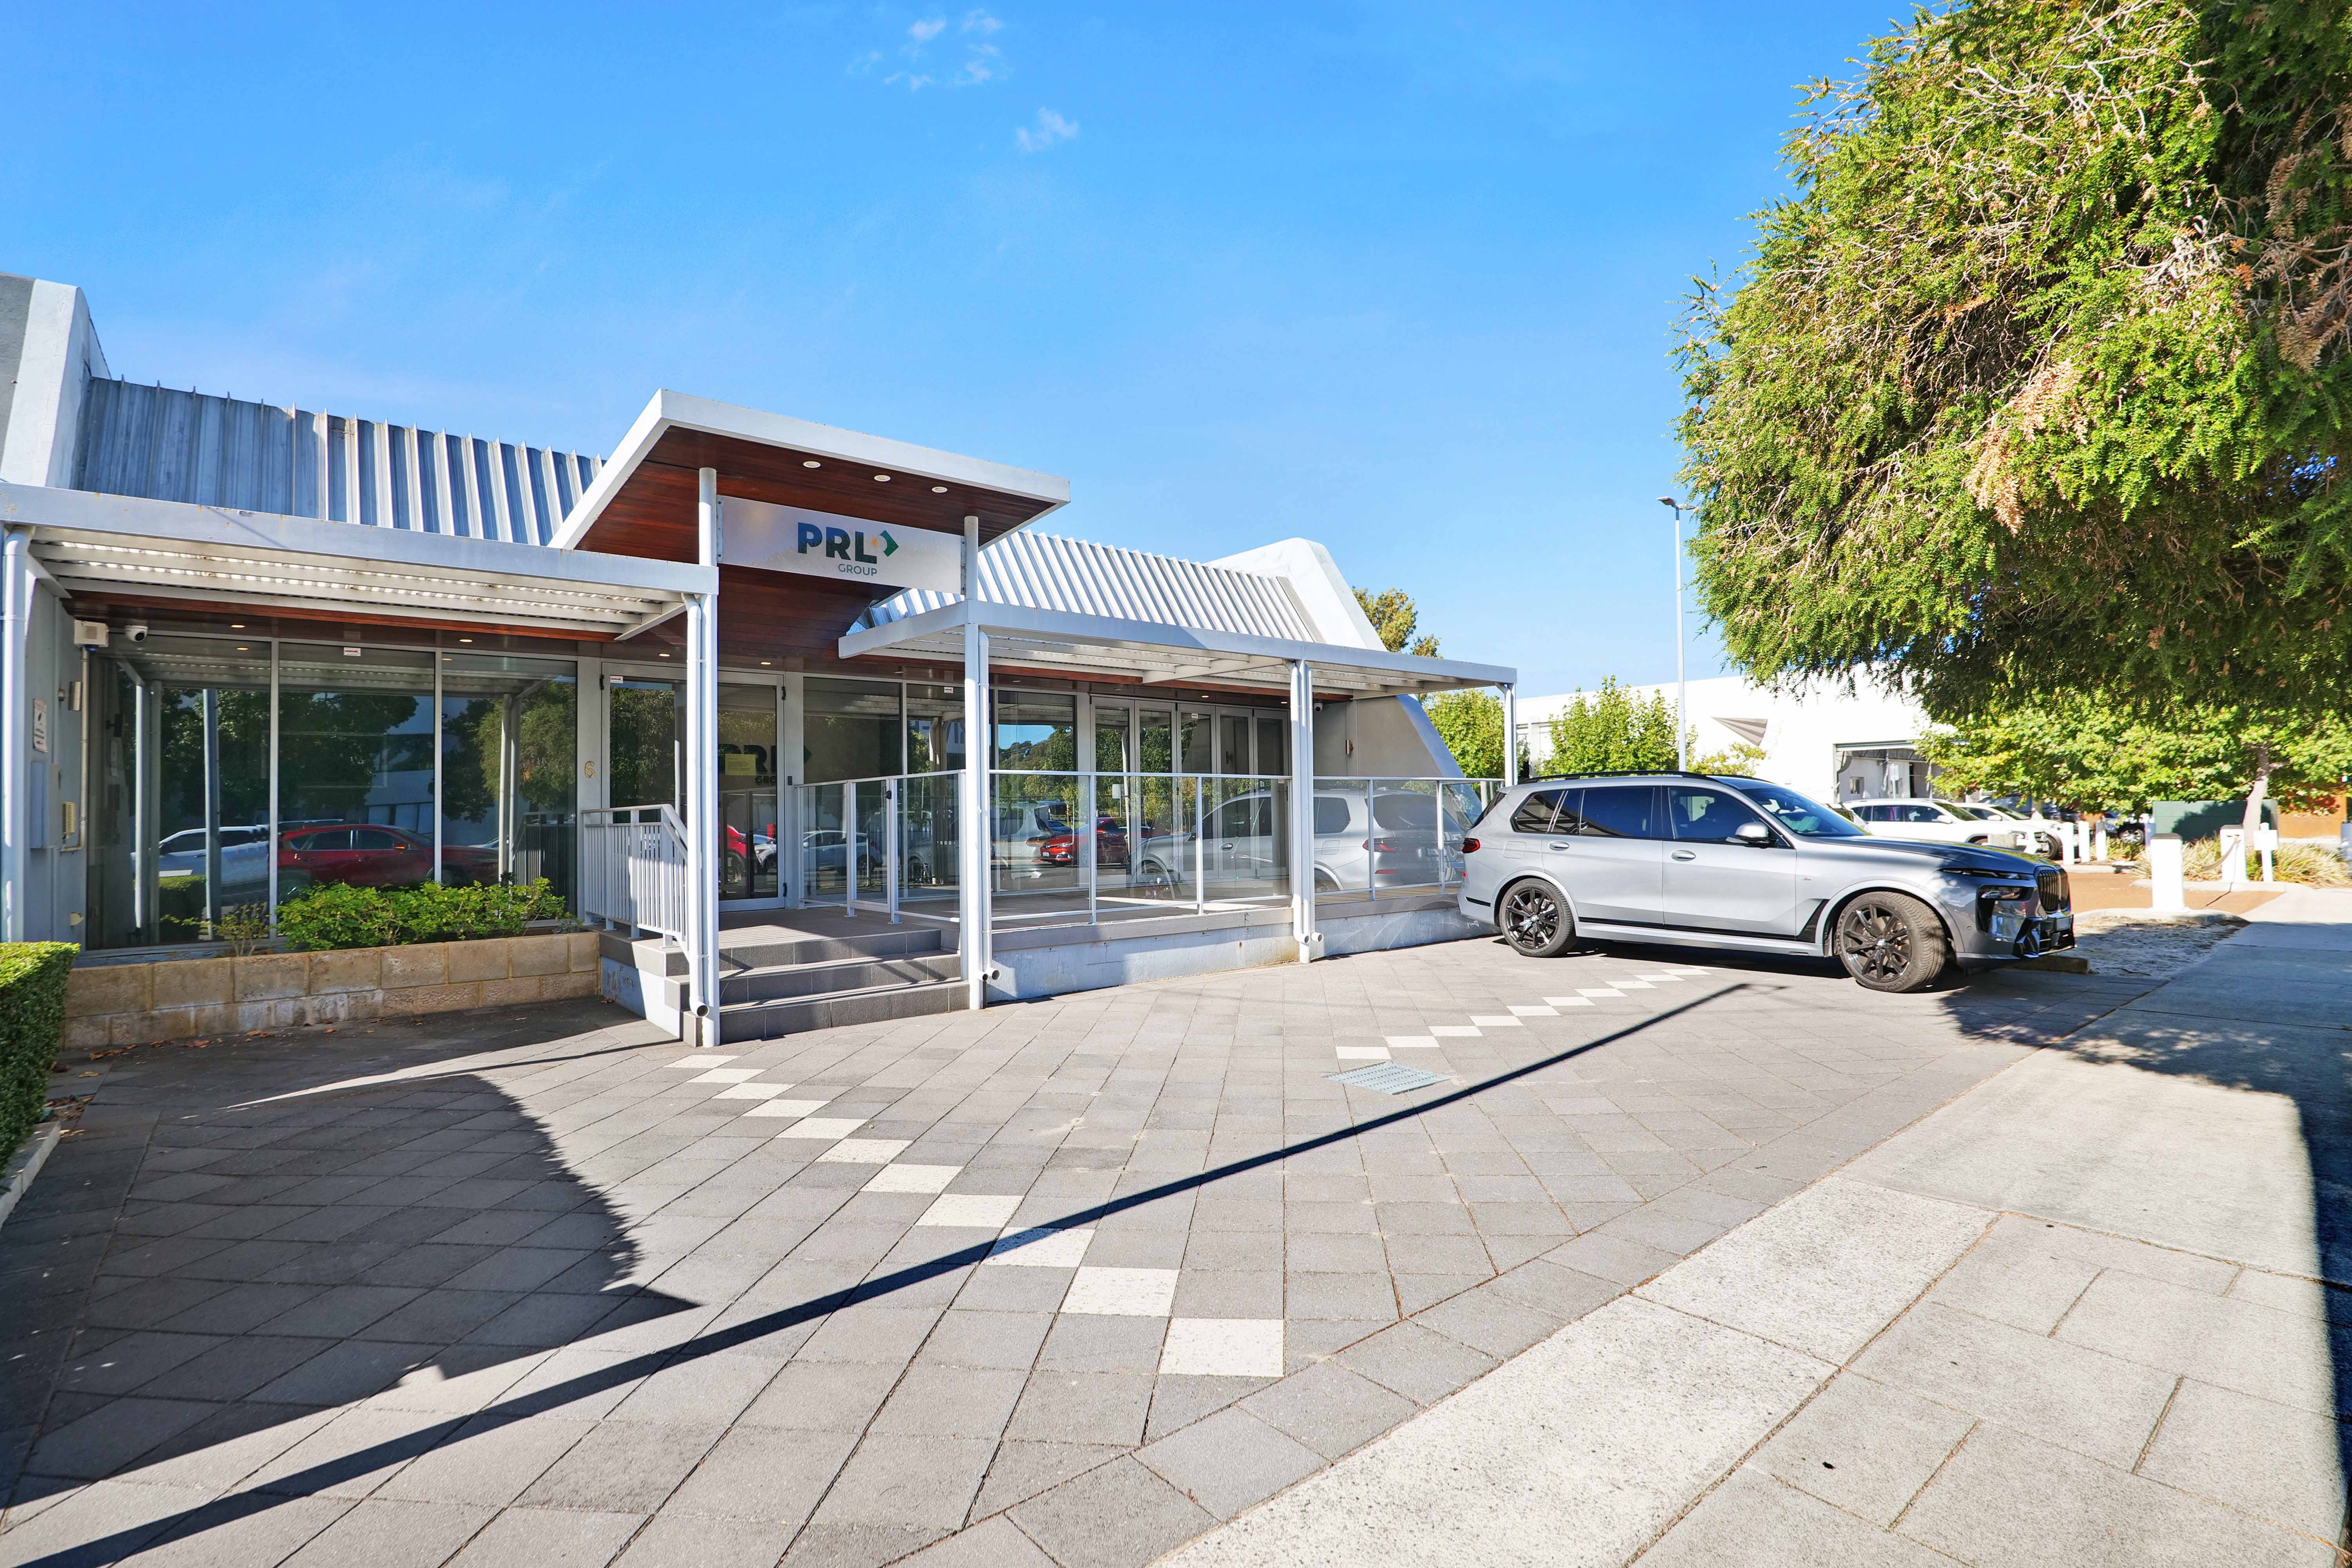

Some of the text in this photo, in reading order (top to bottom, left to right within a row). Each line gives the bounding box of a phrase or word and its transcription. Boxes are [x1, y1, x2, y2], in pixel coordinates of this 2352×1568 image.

[798, 522, 877, 564] PRL
[838, 564, 877, 576] GROUP
[584, 760, 595, 778] 6
